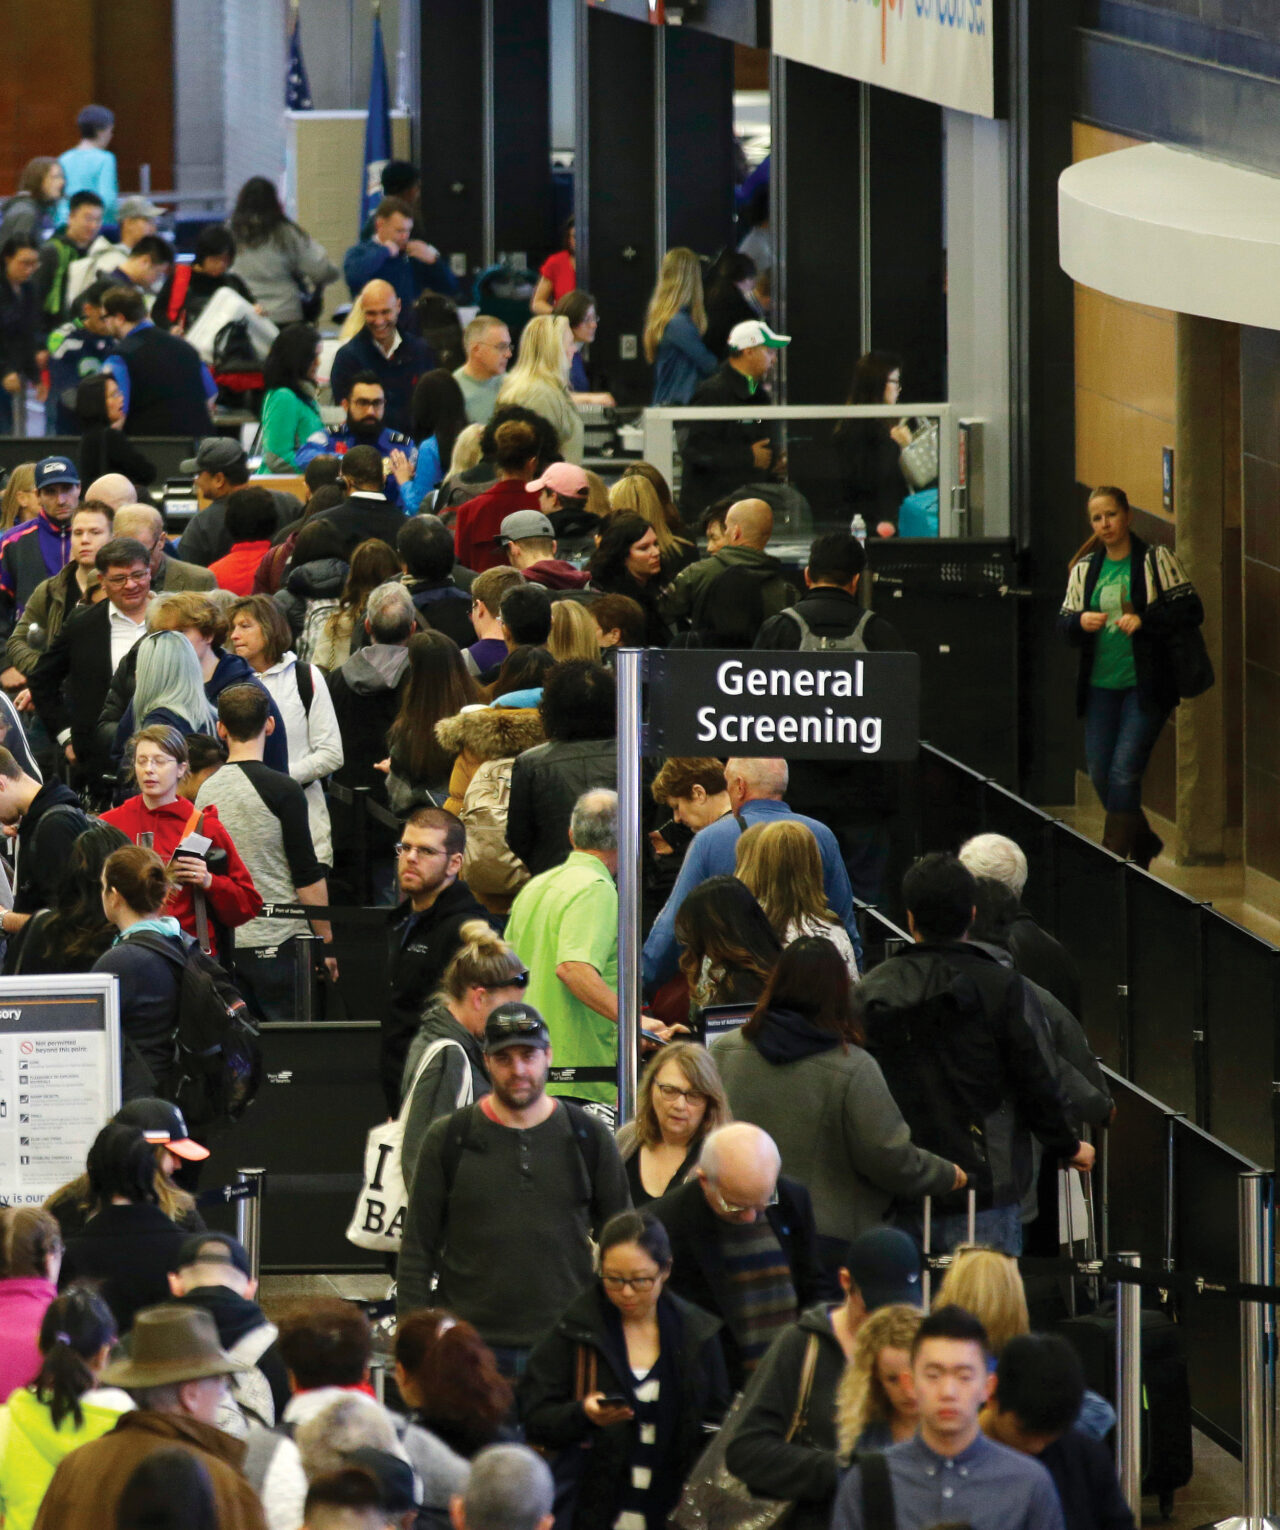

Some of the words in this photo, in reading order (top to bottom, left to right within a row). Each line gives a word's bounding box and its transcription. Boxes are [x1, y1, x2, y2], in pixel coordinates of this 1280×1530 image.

[717, 659, 864, 697] General
[697, 706, 882, 754] Screening
[369, 1143, 394, 1192] I
[13, 1193, 22, 1203] is
[25, 1195, 45, 1203] our
